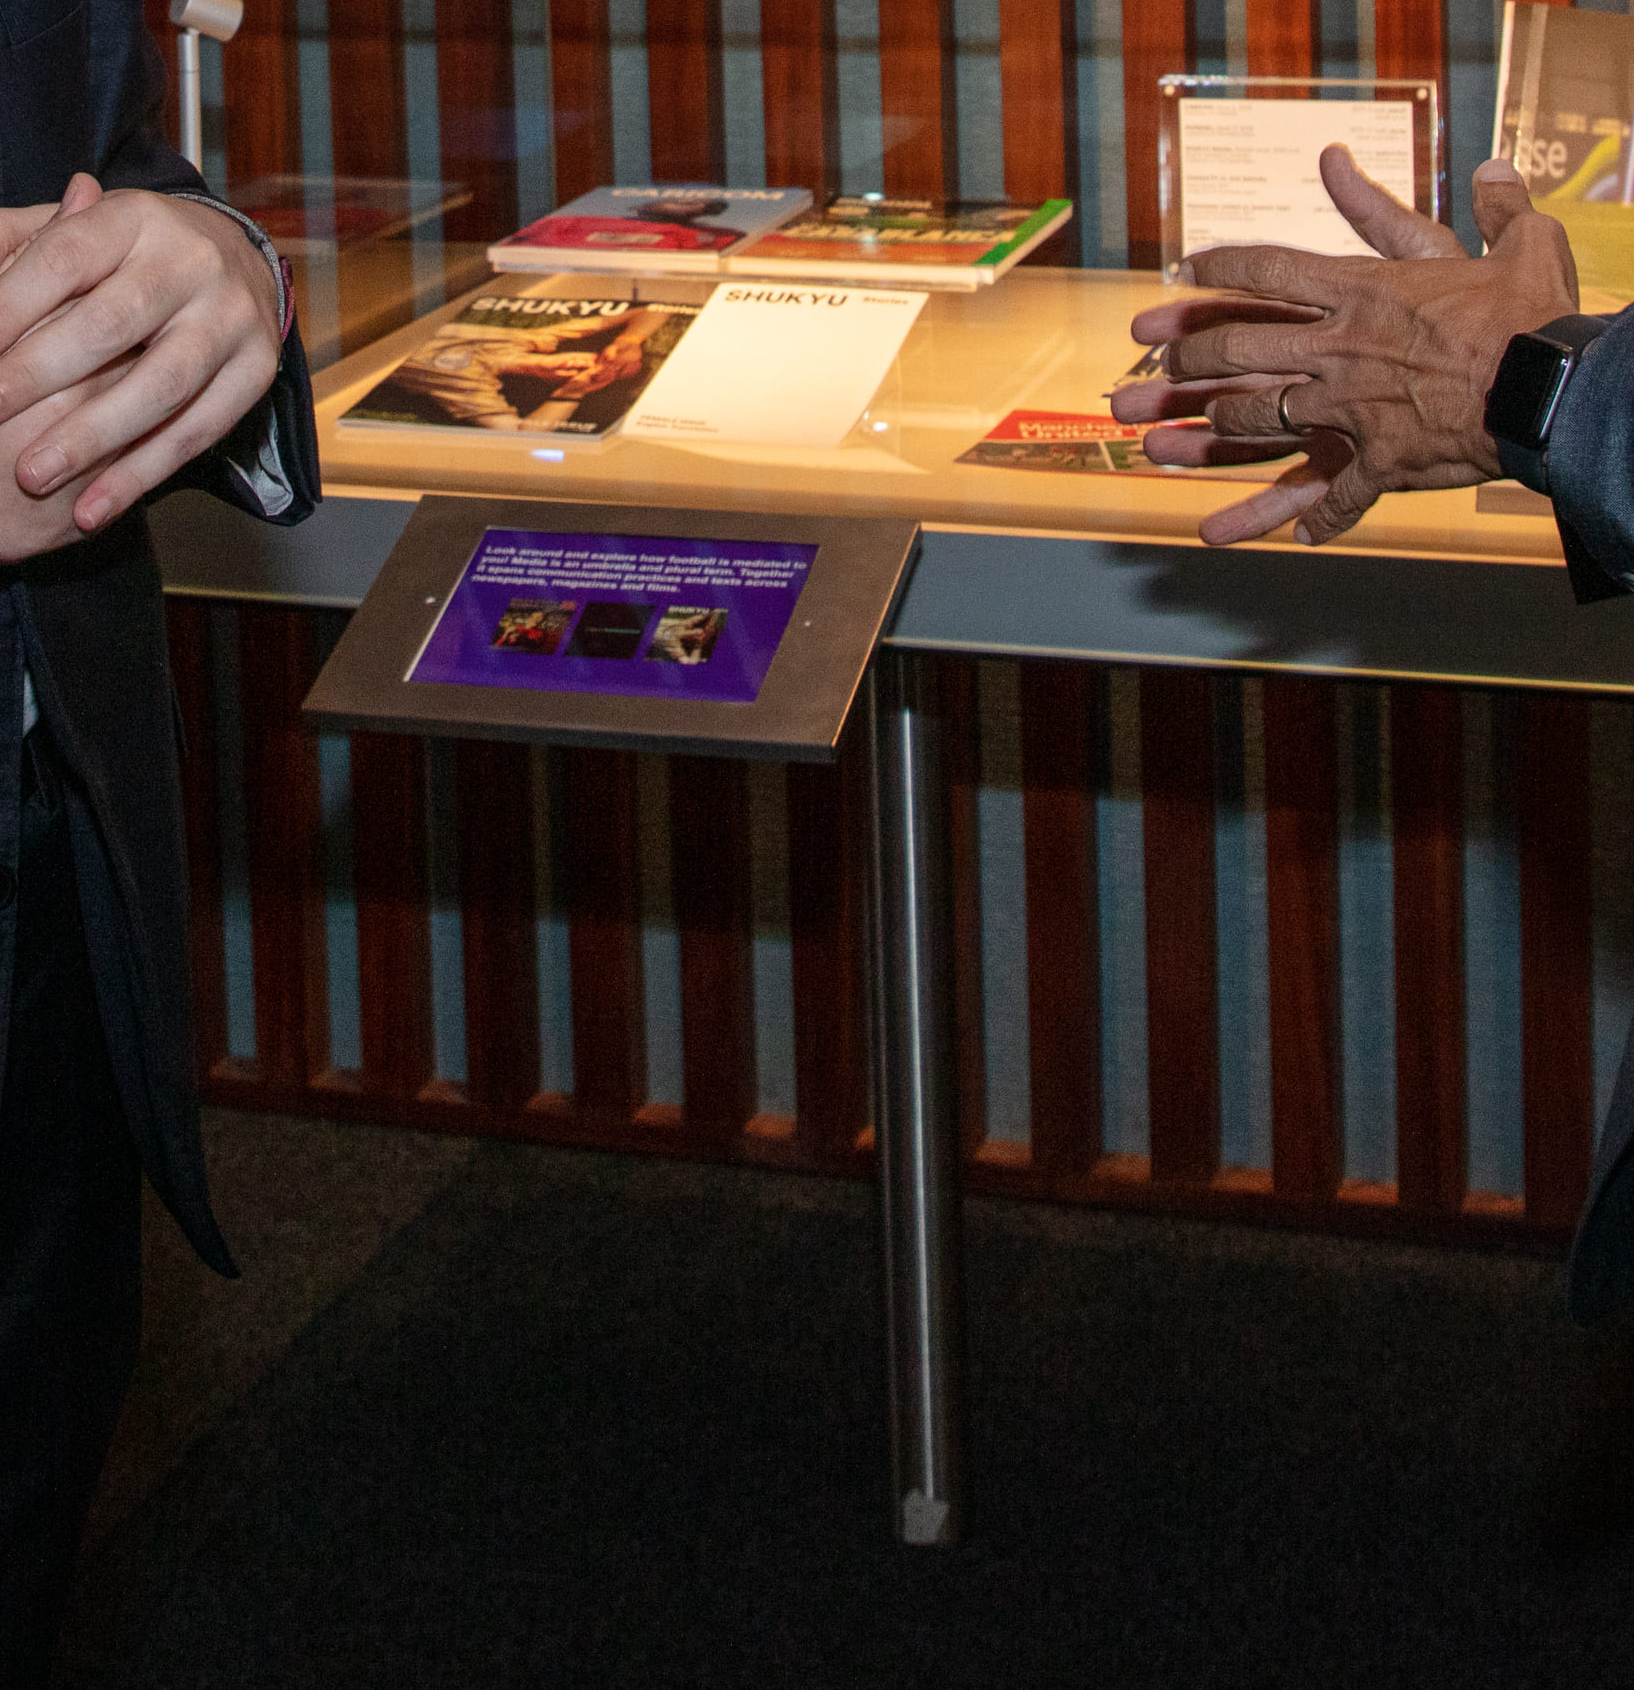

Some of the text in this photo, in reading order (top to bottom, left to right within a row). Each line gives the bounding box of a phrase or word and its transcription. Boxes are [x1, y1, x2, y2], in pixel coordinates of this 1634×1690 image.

[470, 296, 703, 318] SHUKYU Storie
[725, 288, 850, 308] SHUKYU
[485, 544, 807, 570] Look around and explore how football is mediated to
[510, 556, 548, 567] Media
[549, 558, 562, 568] is
[563, 560, 581, 569] an
[582, 560, 637, 572] umbrella
[638, 563, 664, 573] and
[664, 564, 702, 575] plural
[702, 566, 736, 576] term.
[740, 568, 796, 579] Together
[470, 573, 681, 593] newspapers, magazines and films.
[476, 564, 788, 589] it spans communication practices and texts across
